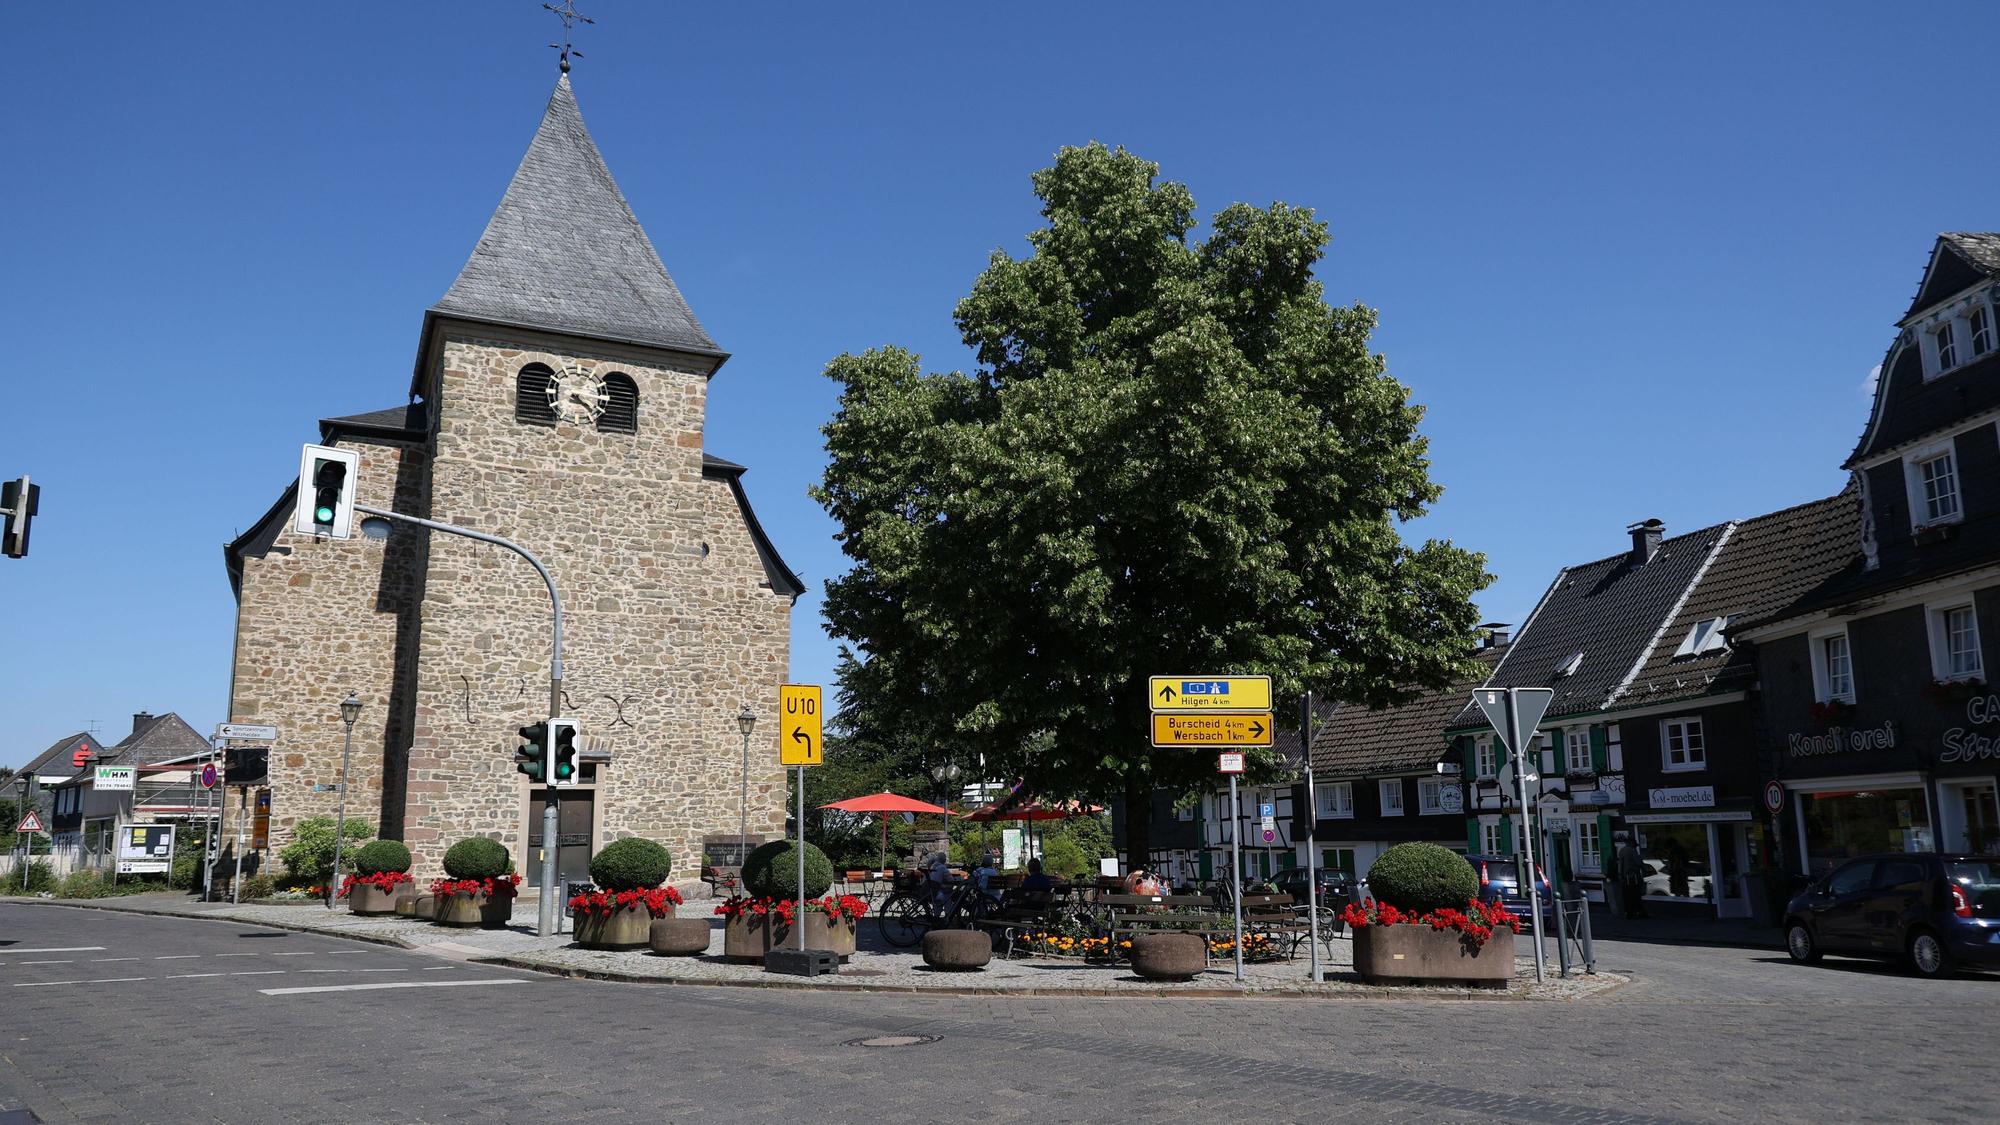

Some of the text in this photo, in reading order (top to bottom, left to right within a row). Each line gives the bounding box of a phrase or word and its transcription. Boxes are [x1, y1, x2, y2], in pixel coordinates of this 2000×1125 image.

[1181, 697, 1209, 707] Hilgen
[1212, 697, 1218, 705] 4
[1169, 718, 1220, 728] Burscheid
[1225, 719, 1231, 728] 4
[1174, 730, 1245, 740] Wersbach 1 km
[97, 768, 128, 778] WHM
[1769, 790, 1779, 804] 10
[1263, 805, 1271, 815] P
